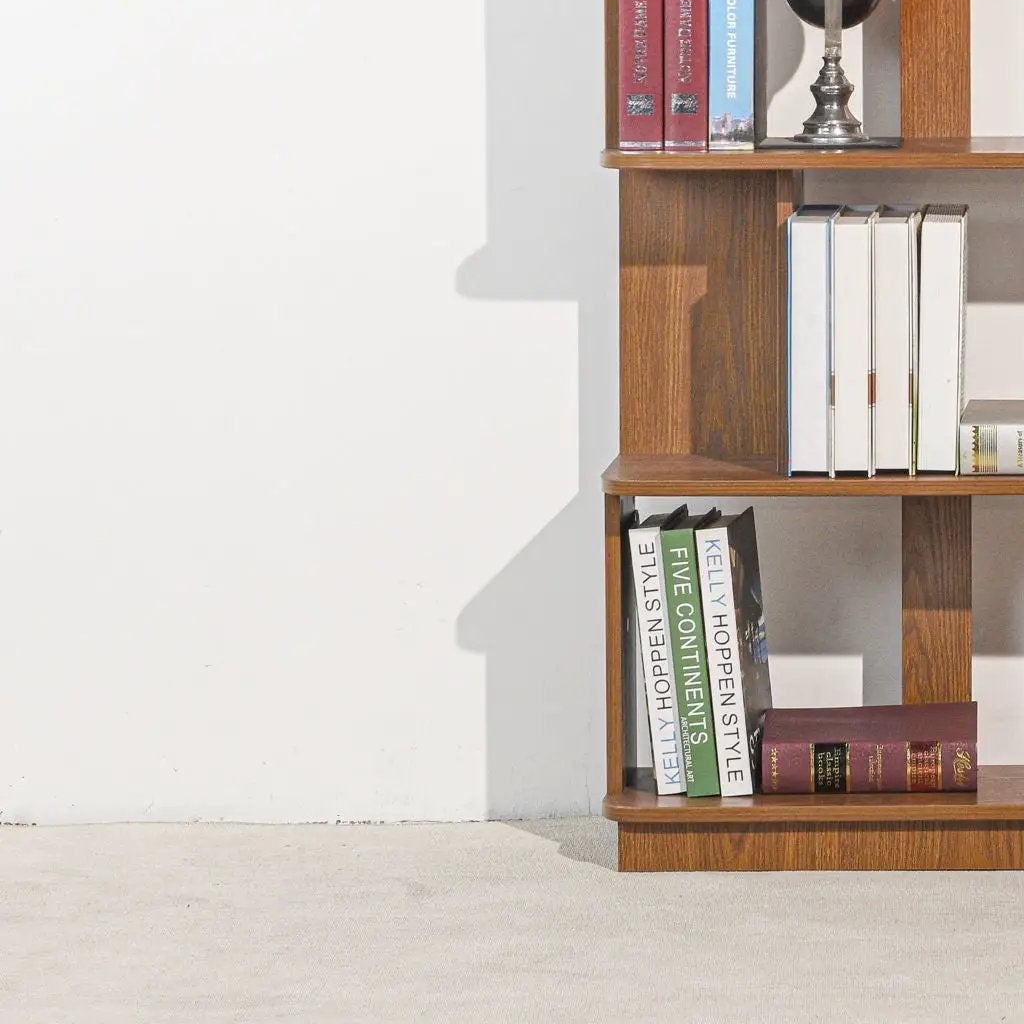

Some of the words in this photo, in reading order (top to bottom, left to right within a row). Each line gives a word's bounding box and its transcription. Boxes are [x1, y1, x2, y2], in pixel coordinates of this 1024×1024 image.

[726, 32, 737, 99] FURNITURE
[638, 543, 662, 612] STYLE
[669, 547, 692, 596] FIVE
[704, 539, 727, 608] KELLY
[646, 619, 673, 710] HOPPEN
[675, 603, 709, 745] CONTINENTS
[712, 614, 737, 707] HOPPEN
[658, 718, 681, 785] KELLY
[680, 716, 693, 769] ARCHITECTURAL
[685, 770, 695, 783] ART
[721, 713, 744, 783] STYLE
